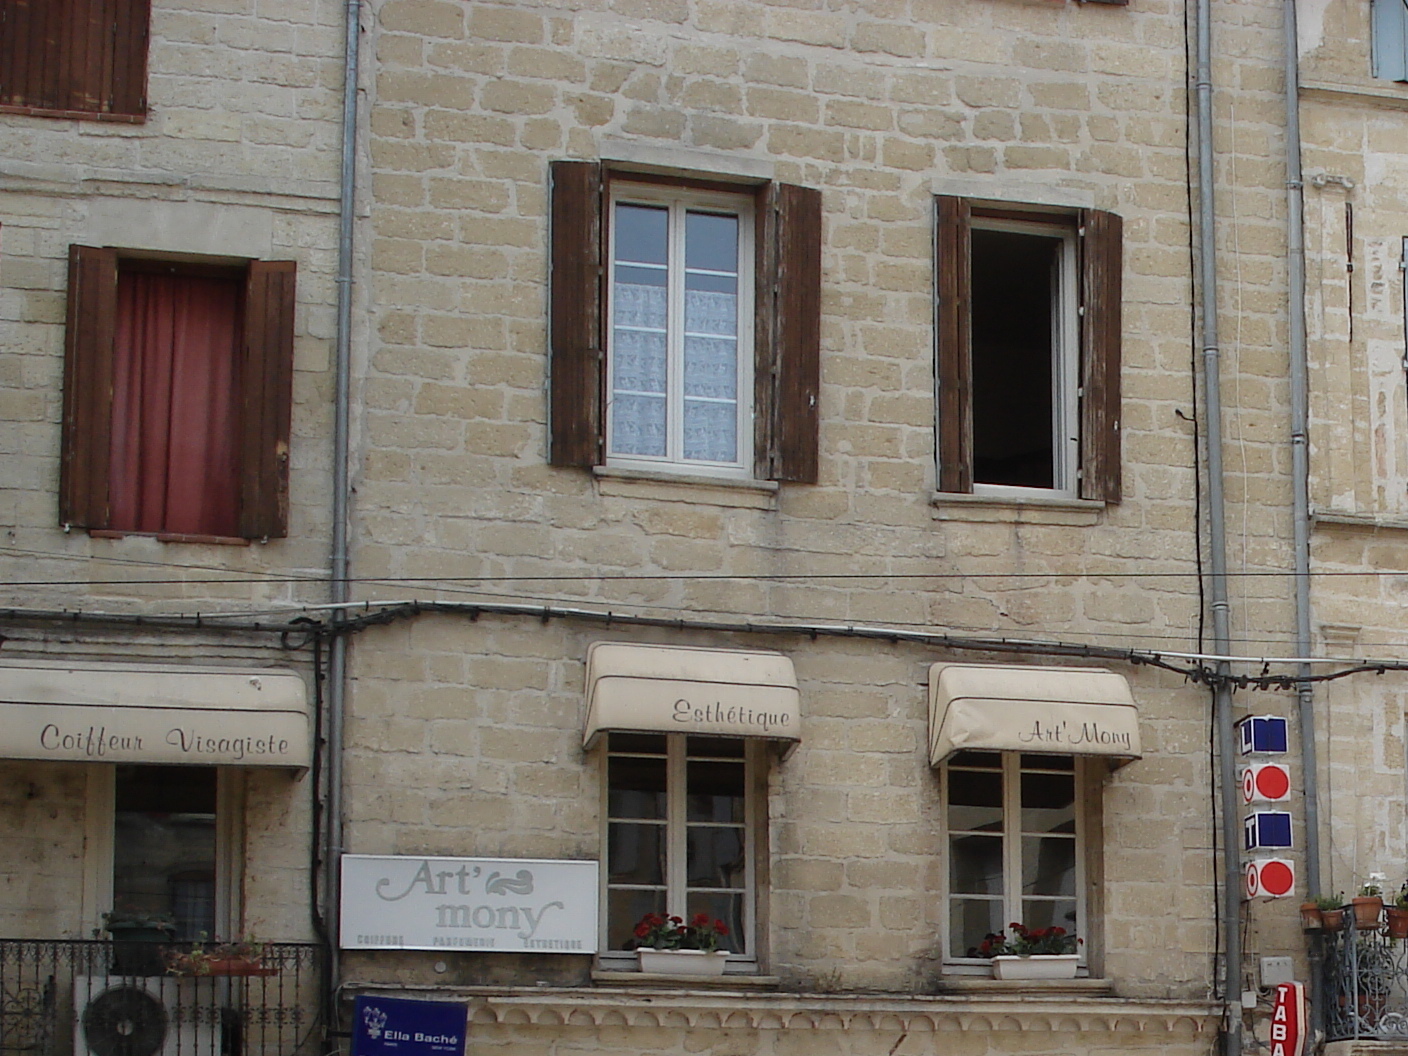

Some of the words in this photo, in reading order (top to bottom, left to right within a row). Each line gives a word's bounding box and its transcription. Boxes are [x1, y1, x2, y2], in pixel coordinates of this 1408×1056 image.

[672, 699, 790, 732] Esthétique
[40, 724, 144, 756] Coiffeur
[165, 728, 289, 760] Visagiste
[1068, 722, 1131, 750] Mony
[375, 860, 482, 901] Art'
[435, 901, 564, 940] mony
[384, 1030, 410, 1041] Ella
[414, 1032, 457, 1045] Baché
